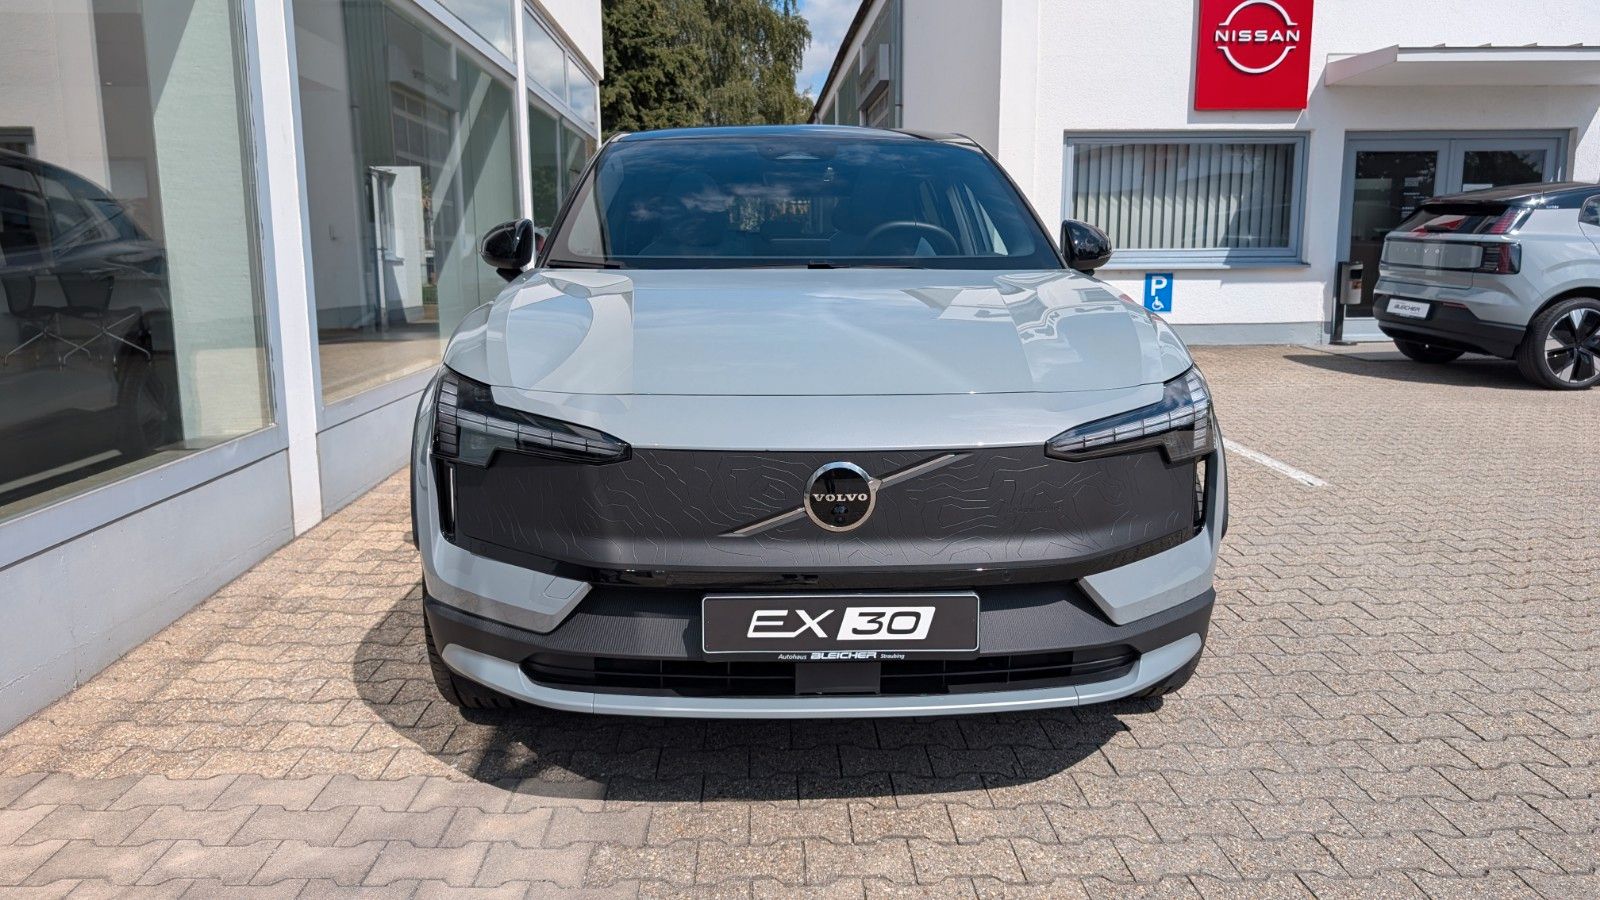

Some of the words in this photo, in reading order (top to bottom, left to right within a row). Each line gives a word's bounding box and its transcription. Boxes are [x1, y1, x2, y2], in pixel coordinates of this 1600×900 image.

[1215, 30, 1300, 42] NISSAN
[1151, 275, 1168, 297] P
[812, 493, 868, 502] VOLVO
[747, 609, 835, 638] EX
[850, 610, 923, 636] 30
[810, 651, 877, 660] BLEICHER
